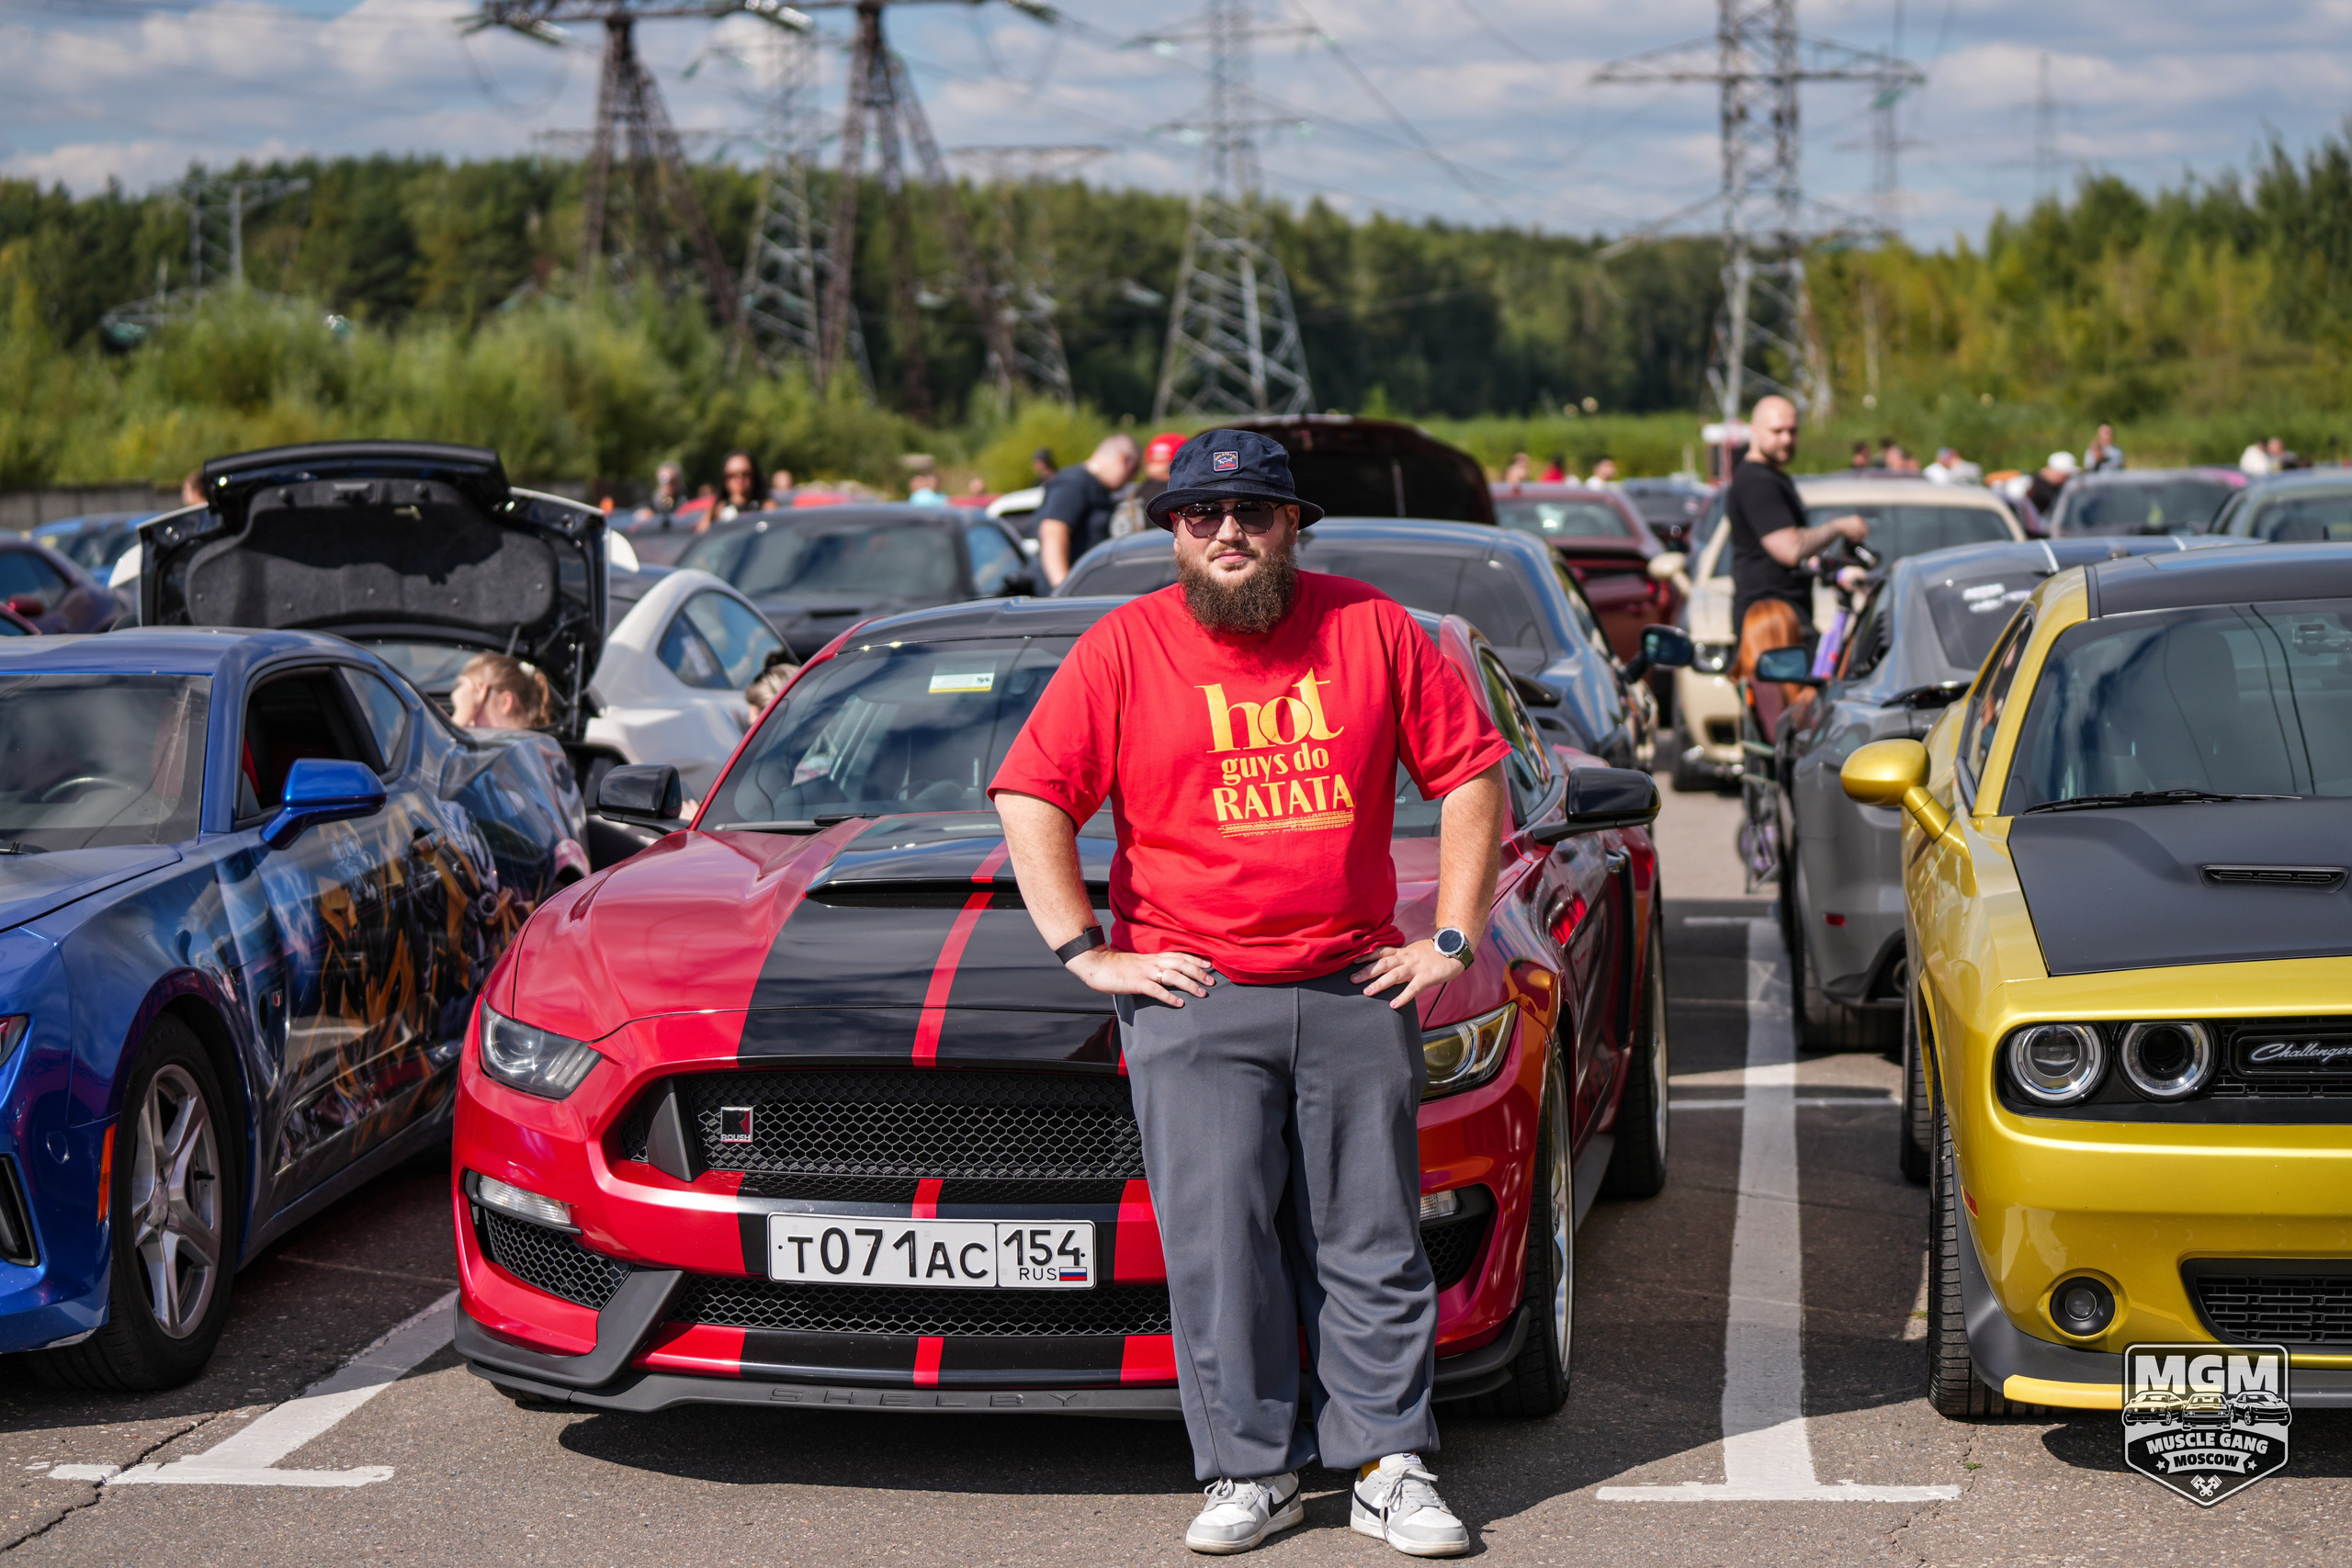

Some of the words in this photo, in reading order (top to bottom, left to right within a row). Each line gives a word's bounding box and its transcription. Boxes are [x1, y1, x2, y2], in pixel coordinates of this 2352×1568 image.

[1193, 667, 1344, 753] hot
[1221, 753, 1289, 786] guys
[1293, 742, 1329, 772] do
[1212, 773, 1354, 822] RATATA
[2250, 1042, 2352, 1062] Challenger
[1003, 1229, 1080, 1267] 154
[1019, 1267, 1057, 1281] RUS
[769, 1389, 1079, 1407] SHELBY
